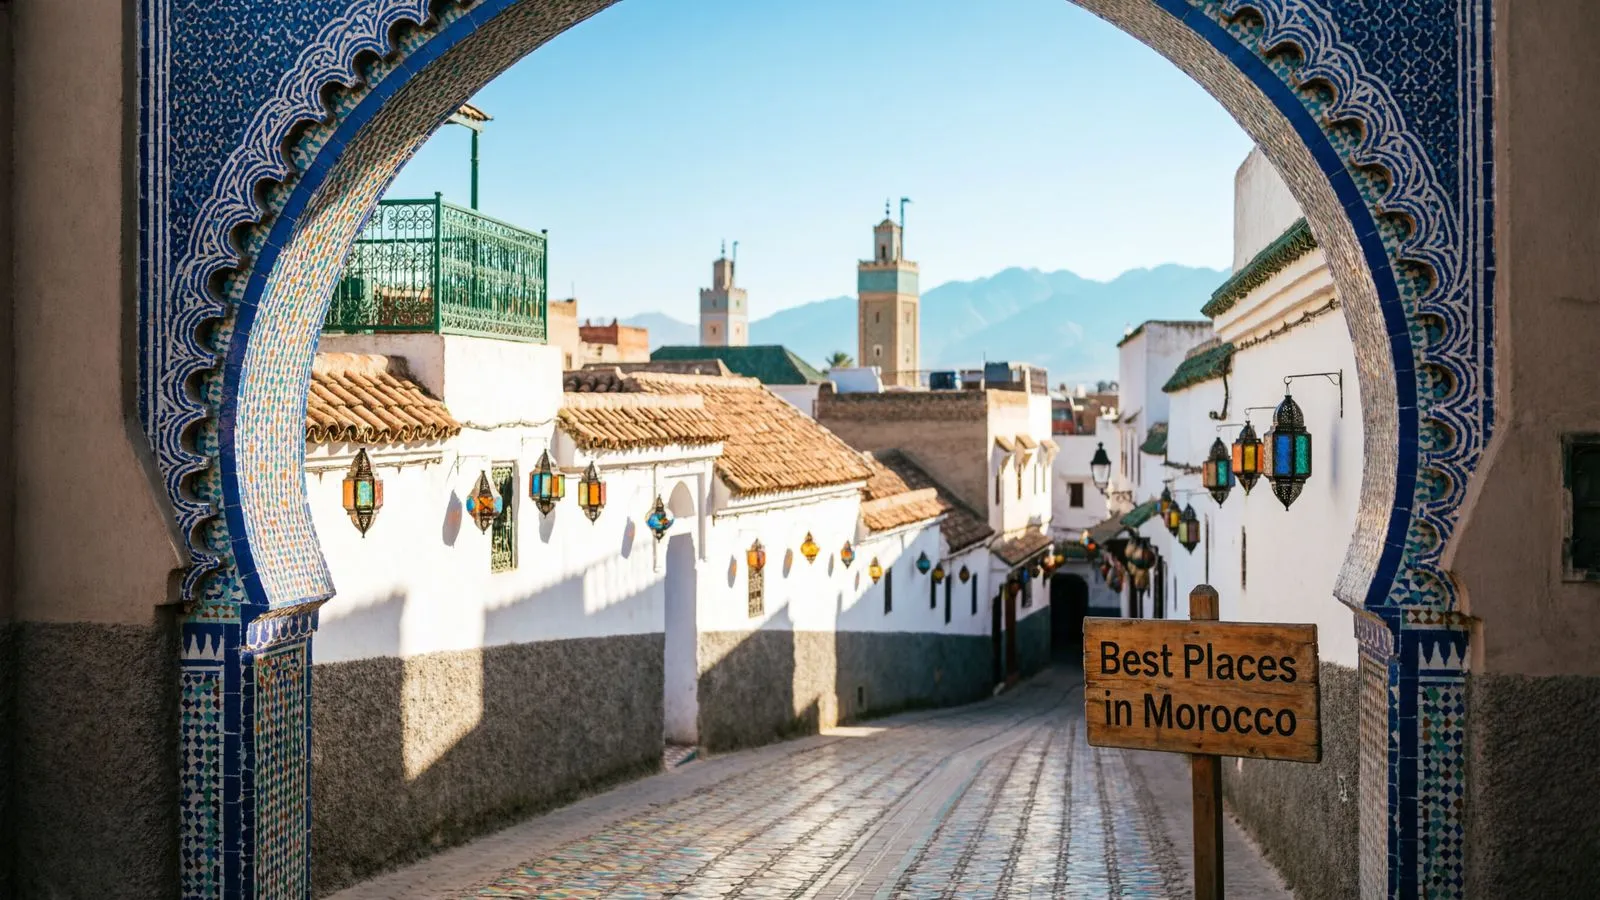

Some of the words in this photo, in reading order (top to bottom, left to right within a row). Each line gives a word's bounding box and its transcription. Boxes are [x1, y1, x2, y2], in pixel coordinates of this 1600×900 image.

[1100, 640, 1174, 679] Best
[1183, 642, 1298, 684] Places
[1104, 689, 1133, 728] in
[1143, 692, 1297, 738] Morocco
